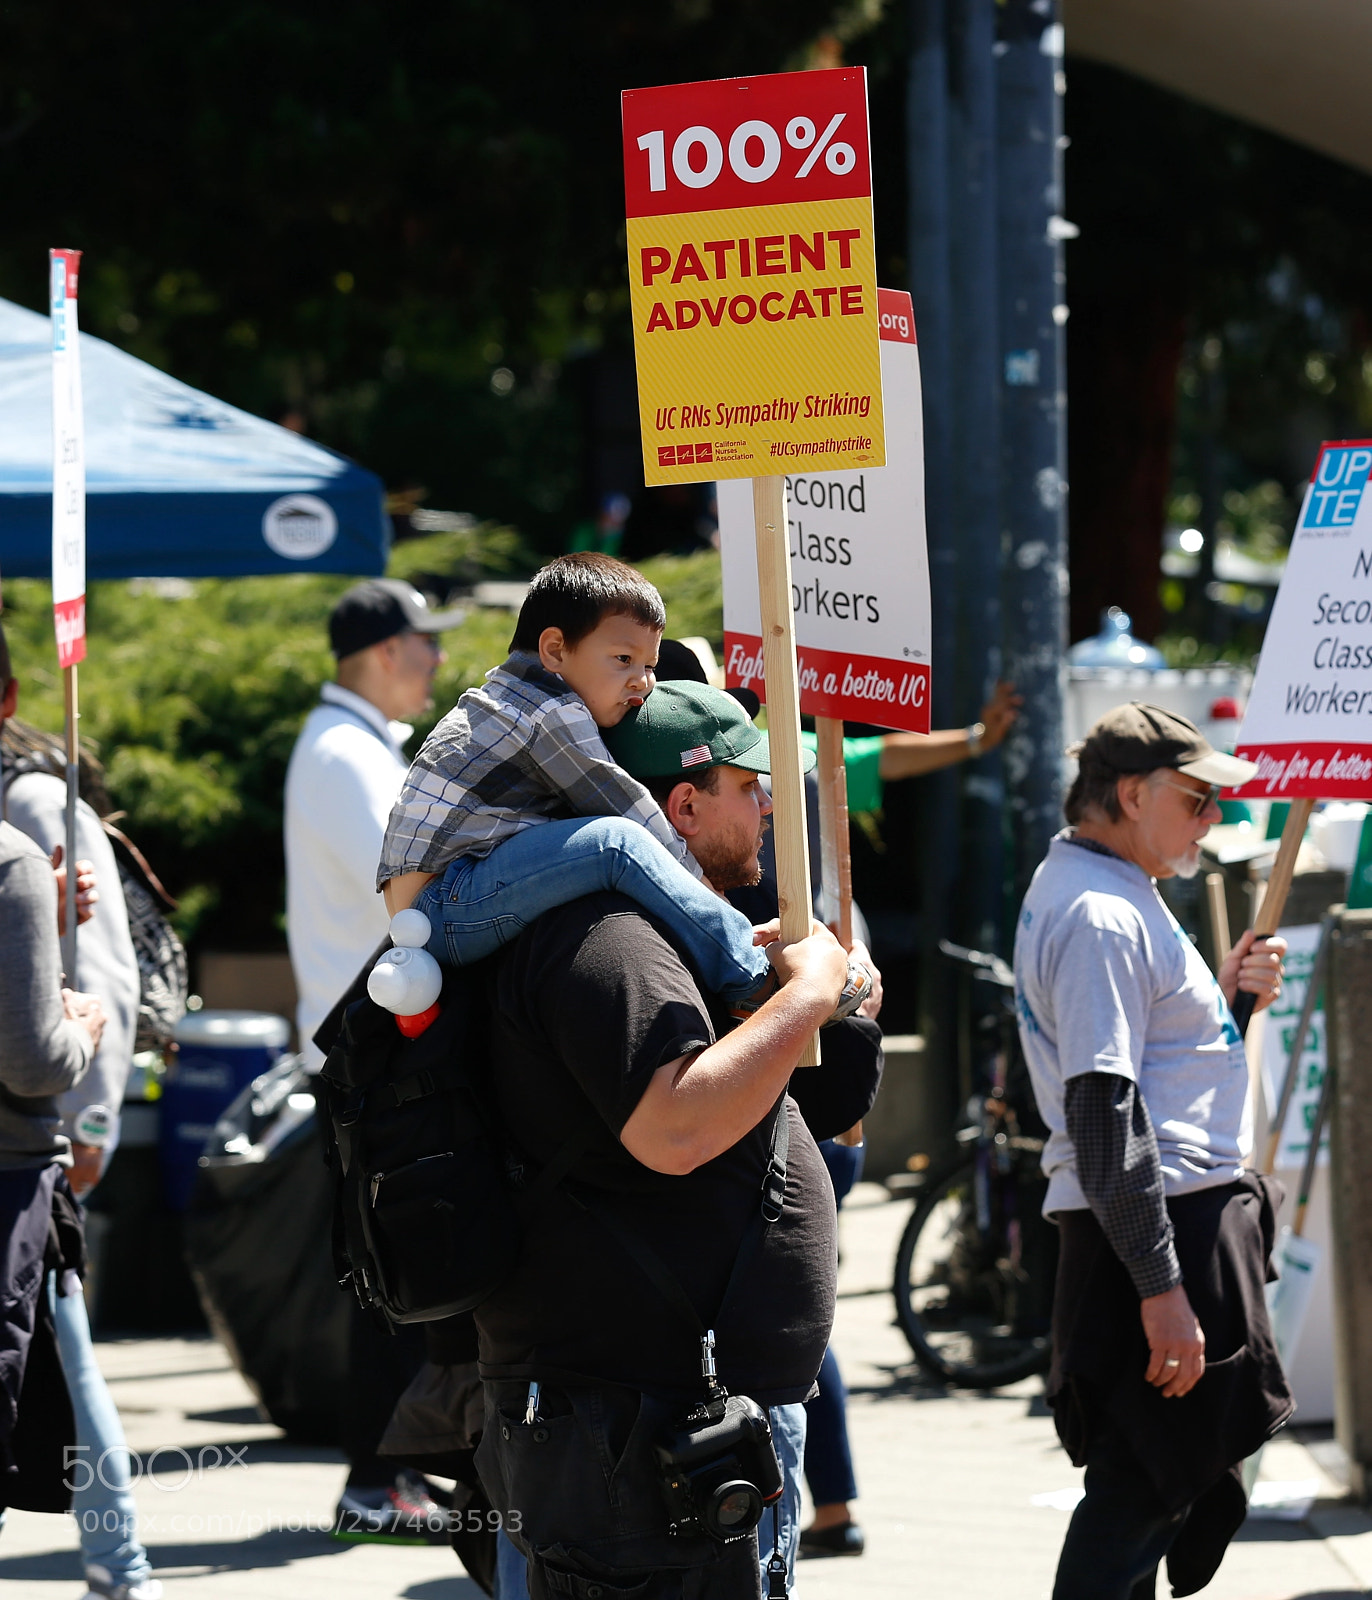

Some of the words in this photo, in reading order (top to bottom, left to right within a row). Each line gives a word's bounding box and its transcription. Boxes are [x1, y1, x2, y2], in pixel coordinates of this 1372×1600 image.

[637, 113, 856, 192] 100%
[640, 228, 861, 287] PATIENT
[645, 285, 864, 333] ADVOCATE
[655, 407, 677, 431] UC
[680, 405, 711, 429] RNs
[716, 398, 799, 429] Sympathy
[803, 392, 871, 418] Striking
[715, 440, 747, 448] California
[715, 453, 754, 462] Association
[770, 435, 872, 457] #UCsympathystrike
[1318, 450, 1372, 487] UP
[1314, 489, 1361, 525] TE
[788, 520, 852, 566] lass
[792, 578, 880, 624] orkers
[1313, 592, 1372, 626] Seco
[823, 673, 838, 695] a
[841, 662, 896, 704] better
[899, 673, 926, 708] UC
[1285, 681, 1372, 715] Worker
[1309, 758, 1325, 779] a
